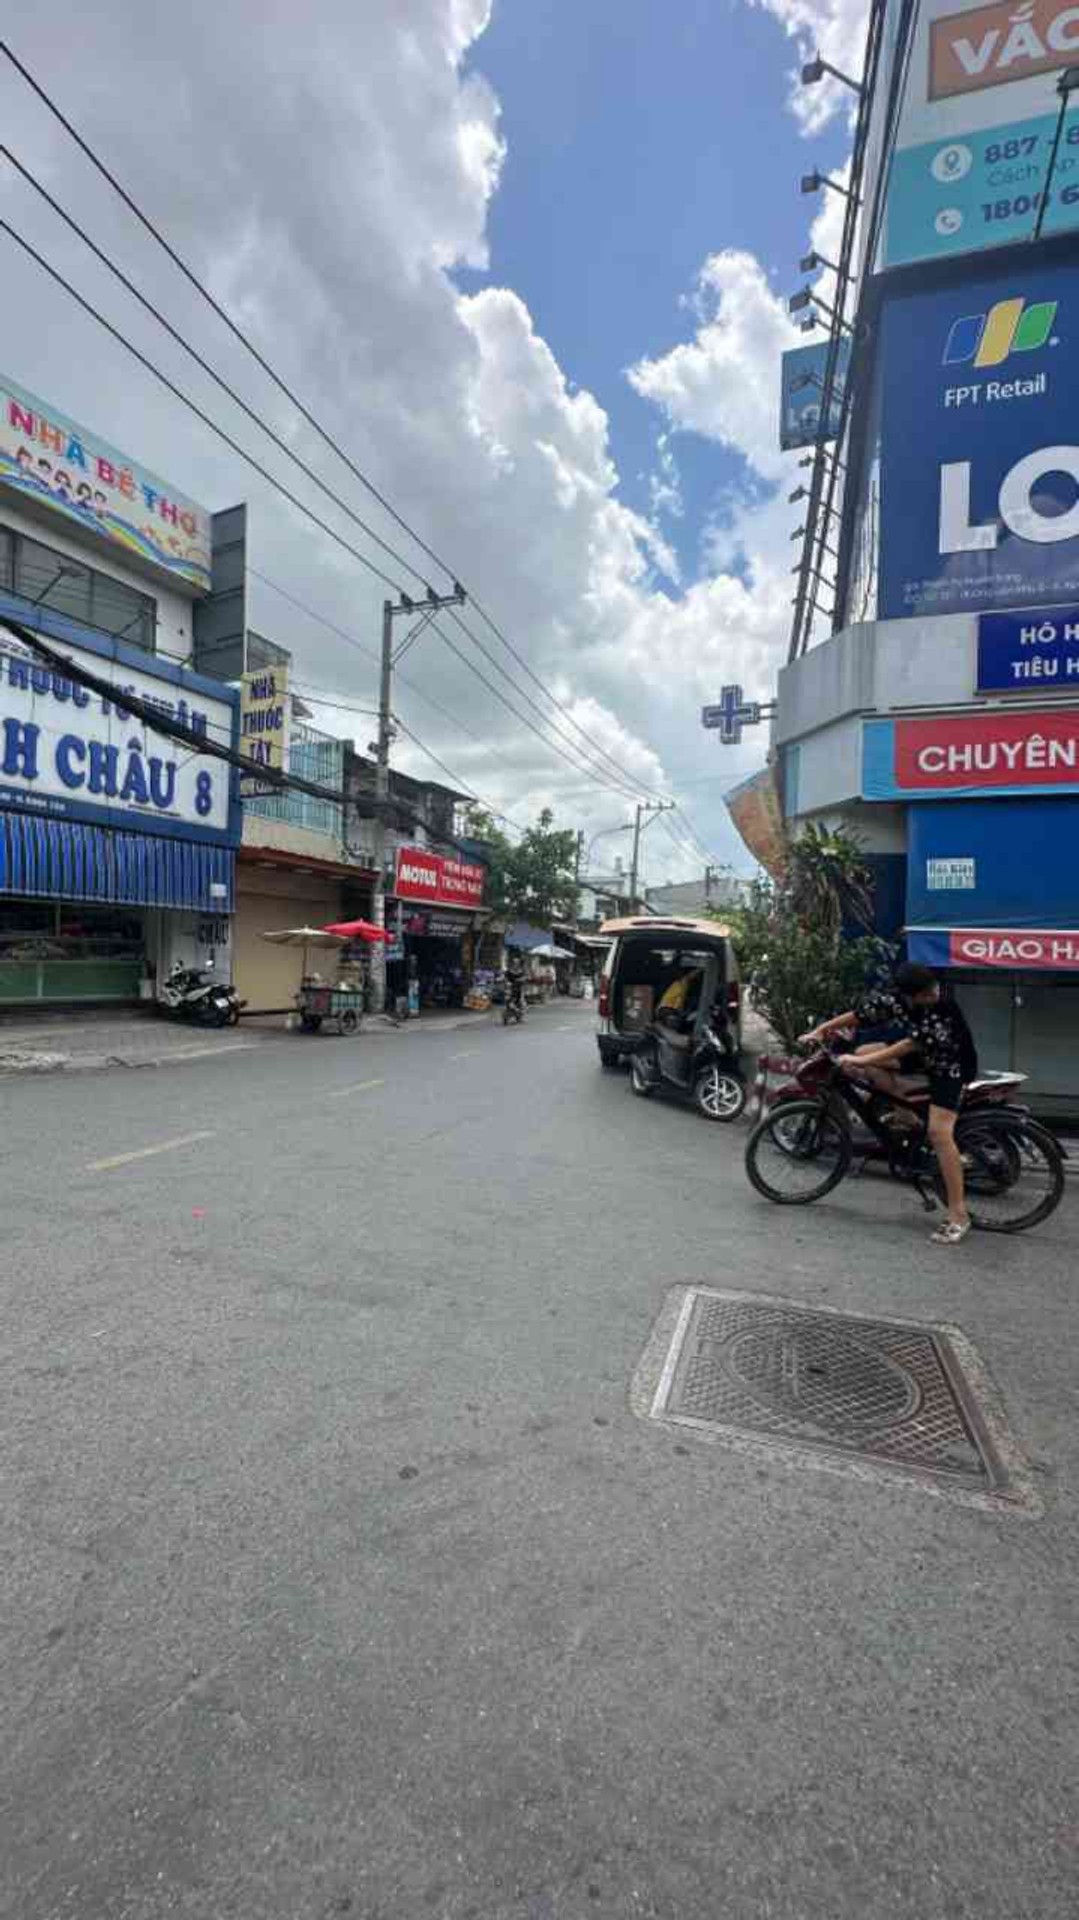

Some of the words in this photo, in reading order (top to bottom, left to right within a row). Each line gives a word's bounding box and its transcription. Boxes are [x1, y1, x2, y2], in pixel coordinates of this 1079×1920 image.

[985, 135, 1038, 164] 887
[944, 384, 982, 408] FPT
[986, 372, 1045, 402] Retail
[938, 445, 1079, 554] LO
[1011, 655, 1058, 678] TIÊU
[917, 734, 1077, 772] CHUYÊN
[55, 736, 177, 809] CHÂU
[194, 770, 213, 816] 8
[961, 938, 1044, 960] GIAO
